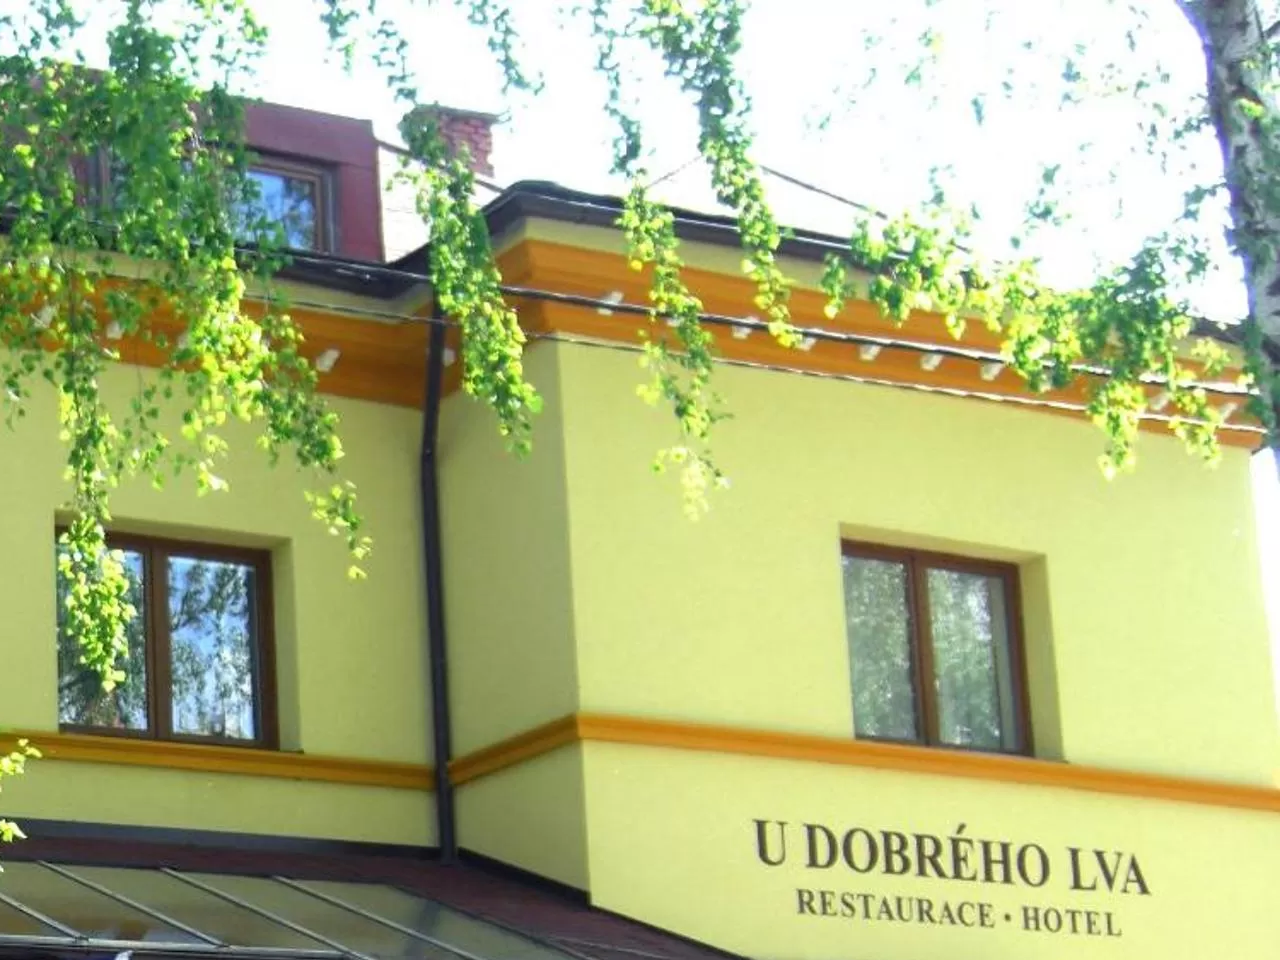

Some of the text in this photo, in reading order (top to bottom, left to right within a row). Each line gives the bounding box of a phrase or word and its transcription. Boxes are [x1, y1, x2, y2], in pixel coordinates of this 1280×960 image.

[753, 819, 1152, 896] U DOBRÉHO LVA
[795, 888, 1122, 937] RESTAURACE HOTEL
